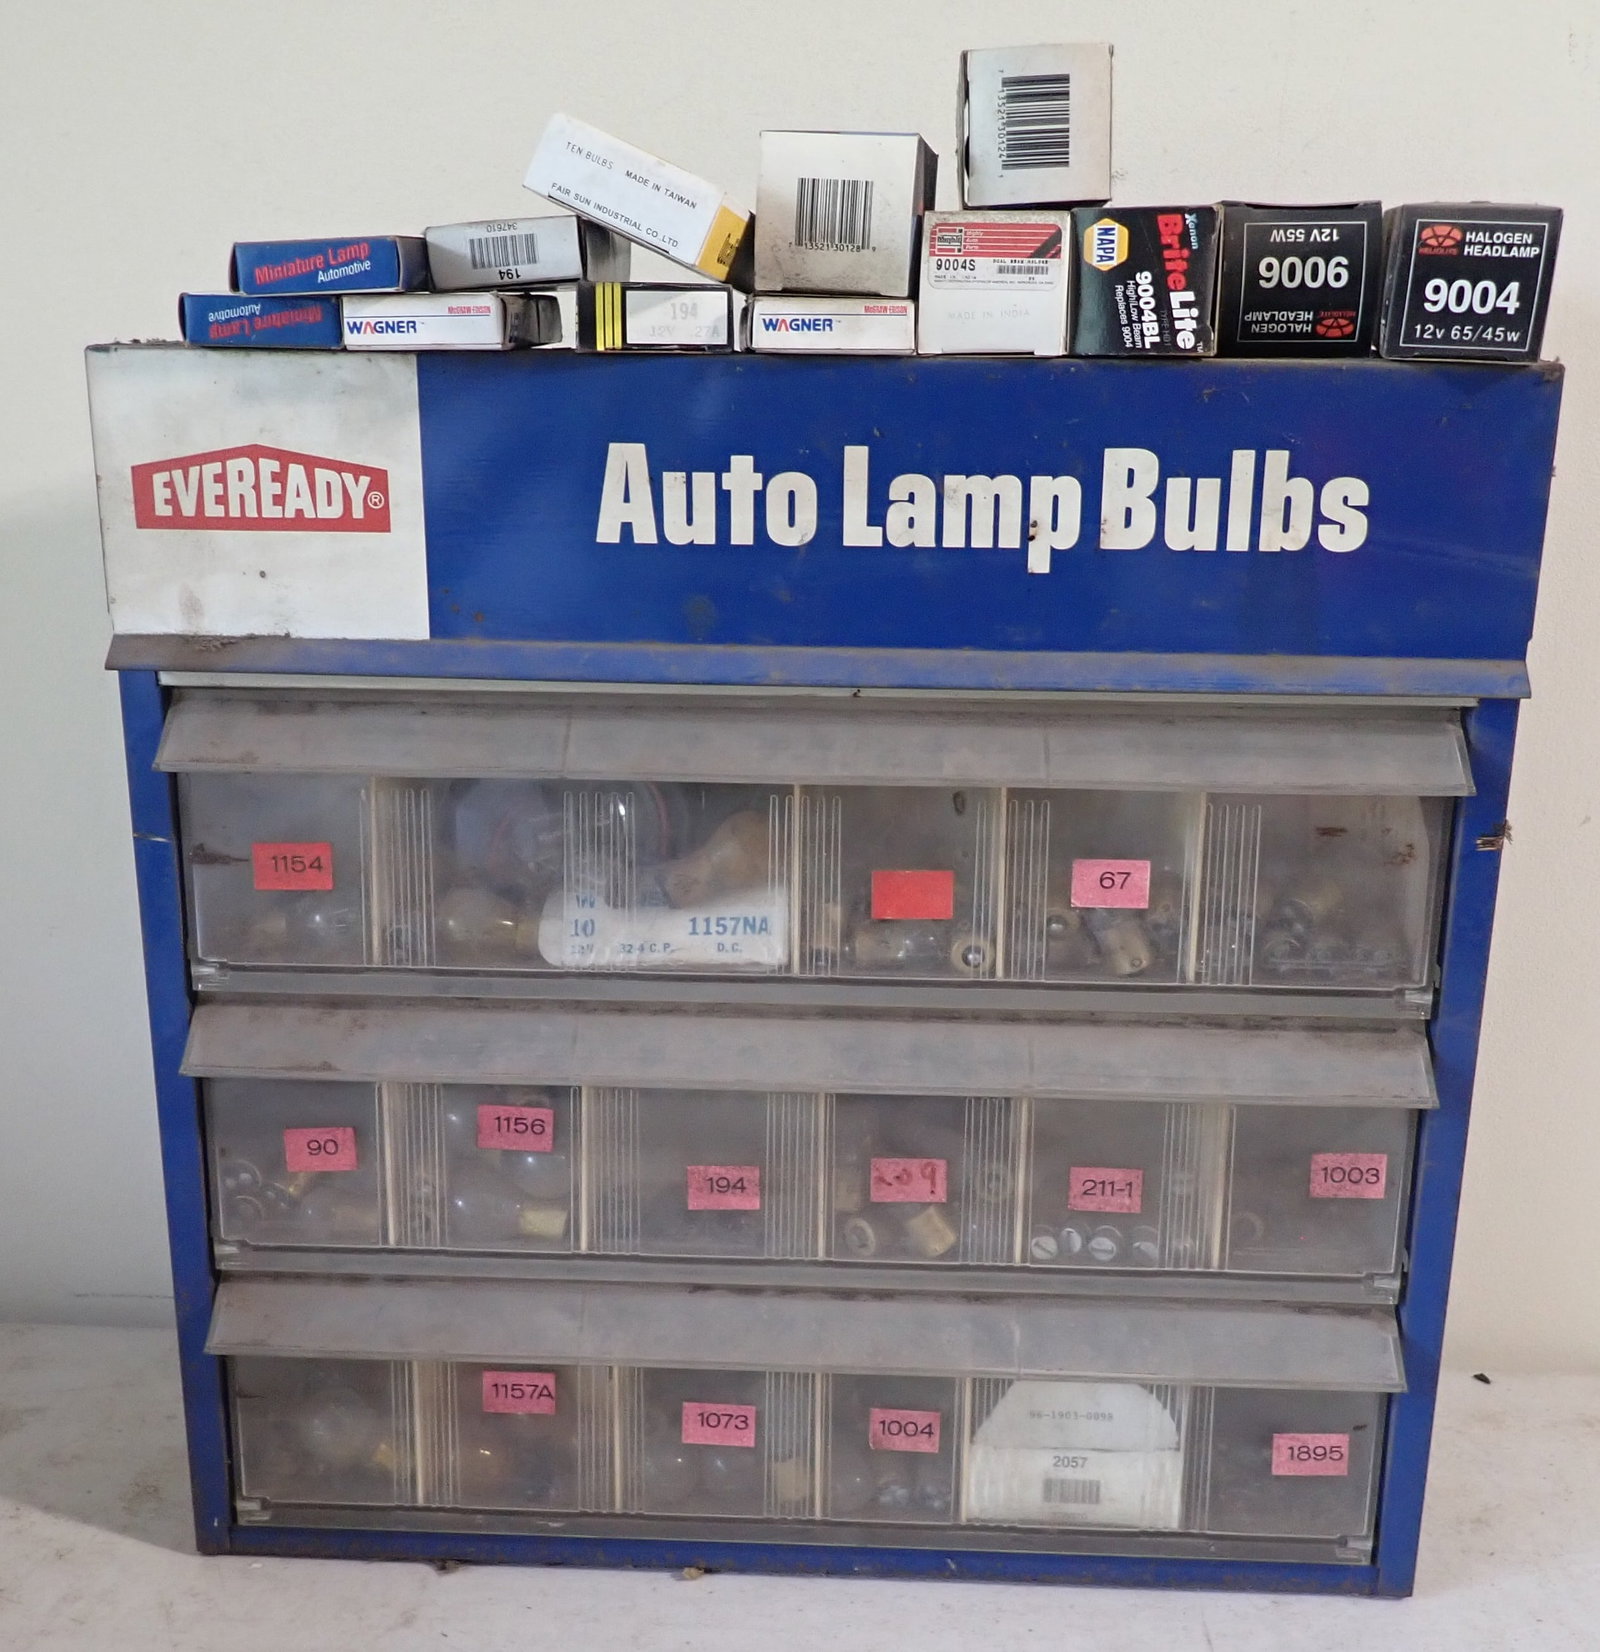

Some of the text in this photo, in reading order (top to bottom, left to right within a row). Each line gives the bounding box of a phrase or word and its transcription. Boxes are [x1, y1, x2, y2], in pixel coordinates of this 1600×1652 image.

[566, 140, 697, 209] TEN BULBS MADE IN TAIWAN
[551, 182, 571, 197] FAIR
[573, 192, 590, 206] SUN
[593, 201, 642, 231] INDUSTRIAL
[486, 222, 518, 232] 347610
[1184, 213, 1198, 249] Xenon
[1270, 228, 1340, 242] 12V 55W
[804, 242, 830, 250] 13521
[833, 243, 861, 252] 30128
[1096, 227, 1116, 263] NAPA
[1466, 232, 1532, 244] HALOGEN
[1464, 245, 1539, 258] HEADLAMP
[254, 241, 370, 286] Miniature Lamp
[318, 259, 371, 284] Automotive
[936, 259, 976, 271] 9004S
[1258, 256, 1349, 288] 9006
[498, 268, 521, 280] 194
[1424, 278, 1520, 315] 9004
[208, 303, 261, 323] Automotive
[671, 302, 698, 320] 194
[947, 312, 976, 320] MADE
[1115, 285, 1133, 348] Replaces 9004
[1126, 280, 1142, 348] High/Low Beam
[1136, 271, 1160, 349] 9004BL
[1244, 311, 1313, 322] HEADLAMP
[209, 305, 323, 340] Miniature Lamp
[346, 320, 417, 334] WAGNER
[762, 318, 833, 332] WAGNER
[1251, 323, 1312, 333] HALOGEN
[1414, 324, 1520, 342] 12v 65/45w
[596, 442, 1370, 574] Auto Lamp Bulbs
[271, 855, 324, 874] 1154
[1099, 871, 1132, 890] 67
[688, 916, 769, 936] 1157NA
[494, 1116, 546, 1135] 1156
[307, 1139, 338, 1156] 90
[1322, 1166, 1380, 1185] 1003
[706, 1177, 747, 1194] 194
[1082, 1179, 1133, 1198] 211-1
[491, 1382, 554, 1400] 1157A
[698, 1412, 749, 1431] 1073
[879, 1419, 934, 1438] 1004
[1052, 1455, 1088, 1469] 2057
[1287, 1445, 1344, 1462] 1895
